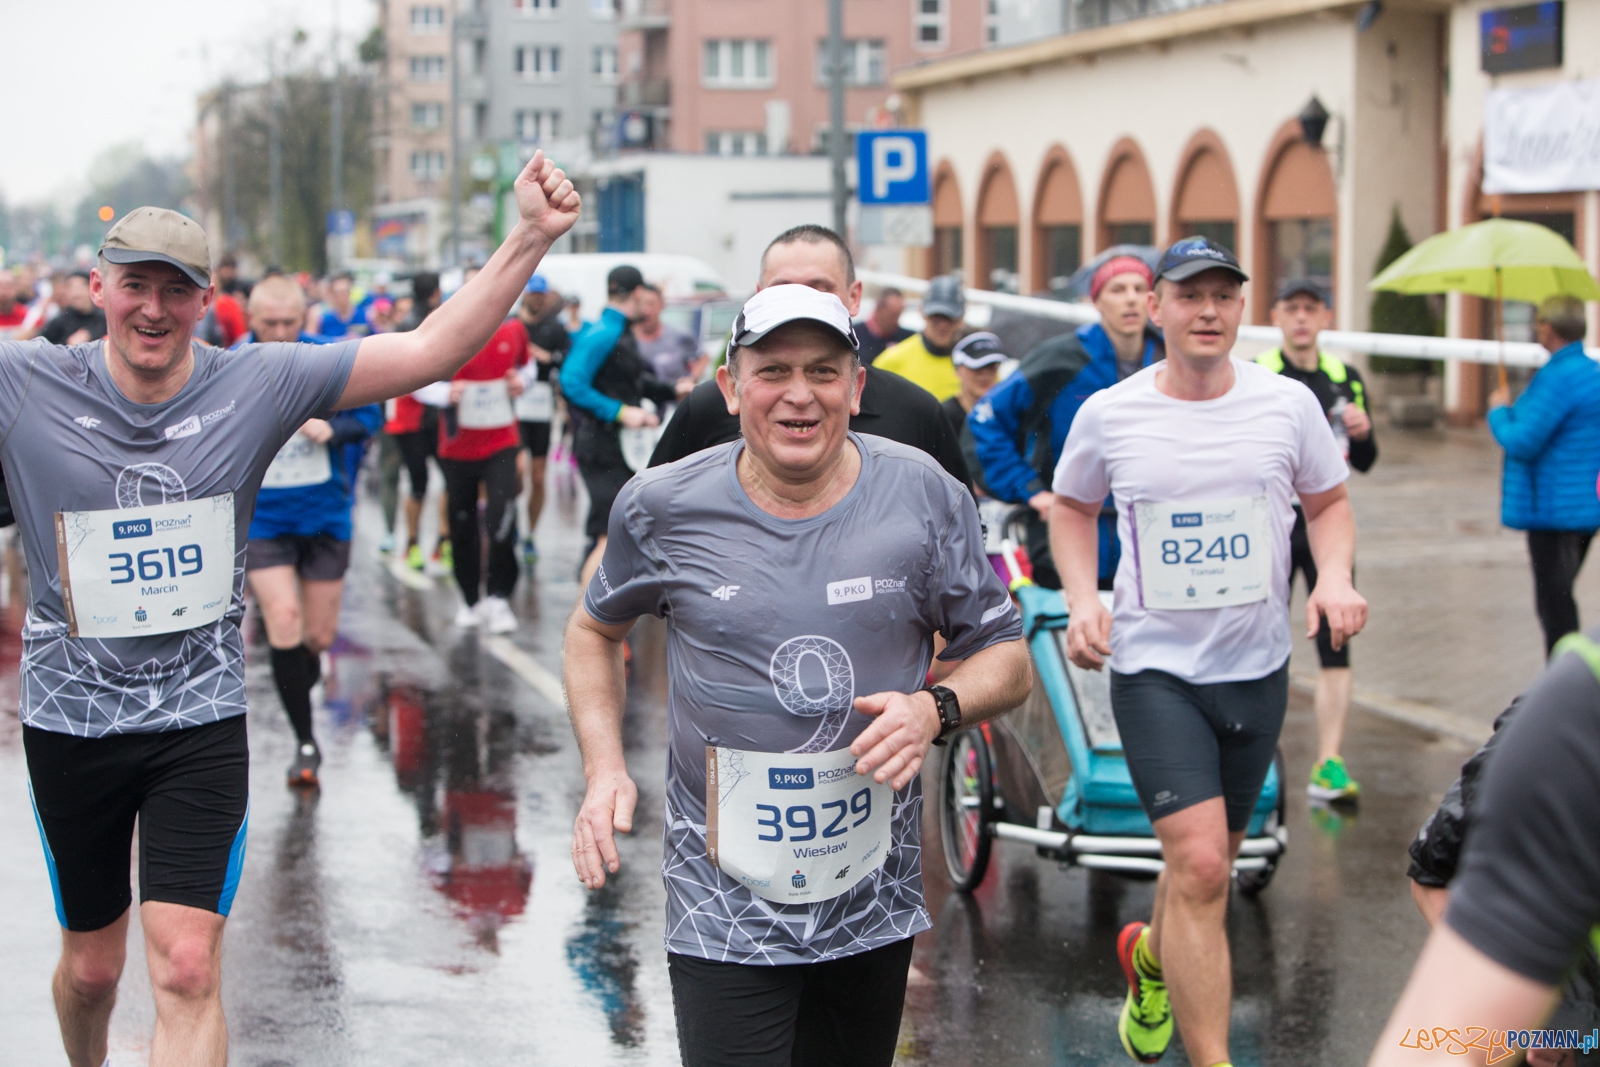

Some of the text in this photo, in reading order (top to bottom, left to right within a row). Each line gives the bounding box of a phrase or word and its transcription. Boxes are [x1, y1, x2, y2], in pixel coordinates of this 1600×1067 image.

[872, 136, 917, 199] P
[73, 415, 101, 429] 4F
[1161, 533, 1250, 565] 8240
[108, 543, 203, 585] 3619
[1190, 567, 1225, 576] Tomasz
[141, 583, 179, 596] Marcin
[711, 585, 741, 601] 4F
[171, 606, 188, 617] 4F
[756, 787, 872, 843] 3929
[793, 841, 848, 859] Wiesław
[834, 864, 851, 880] 4F
